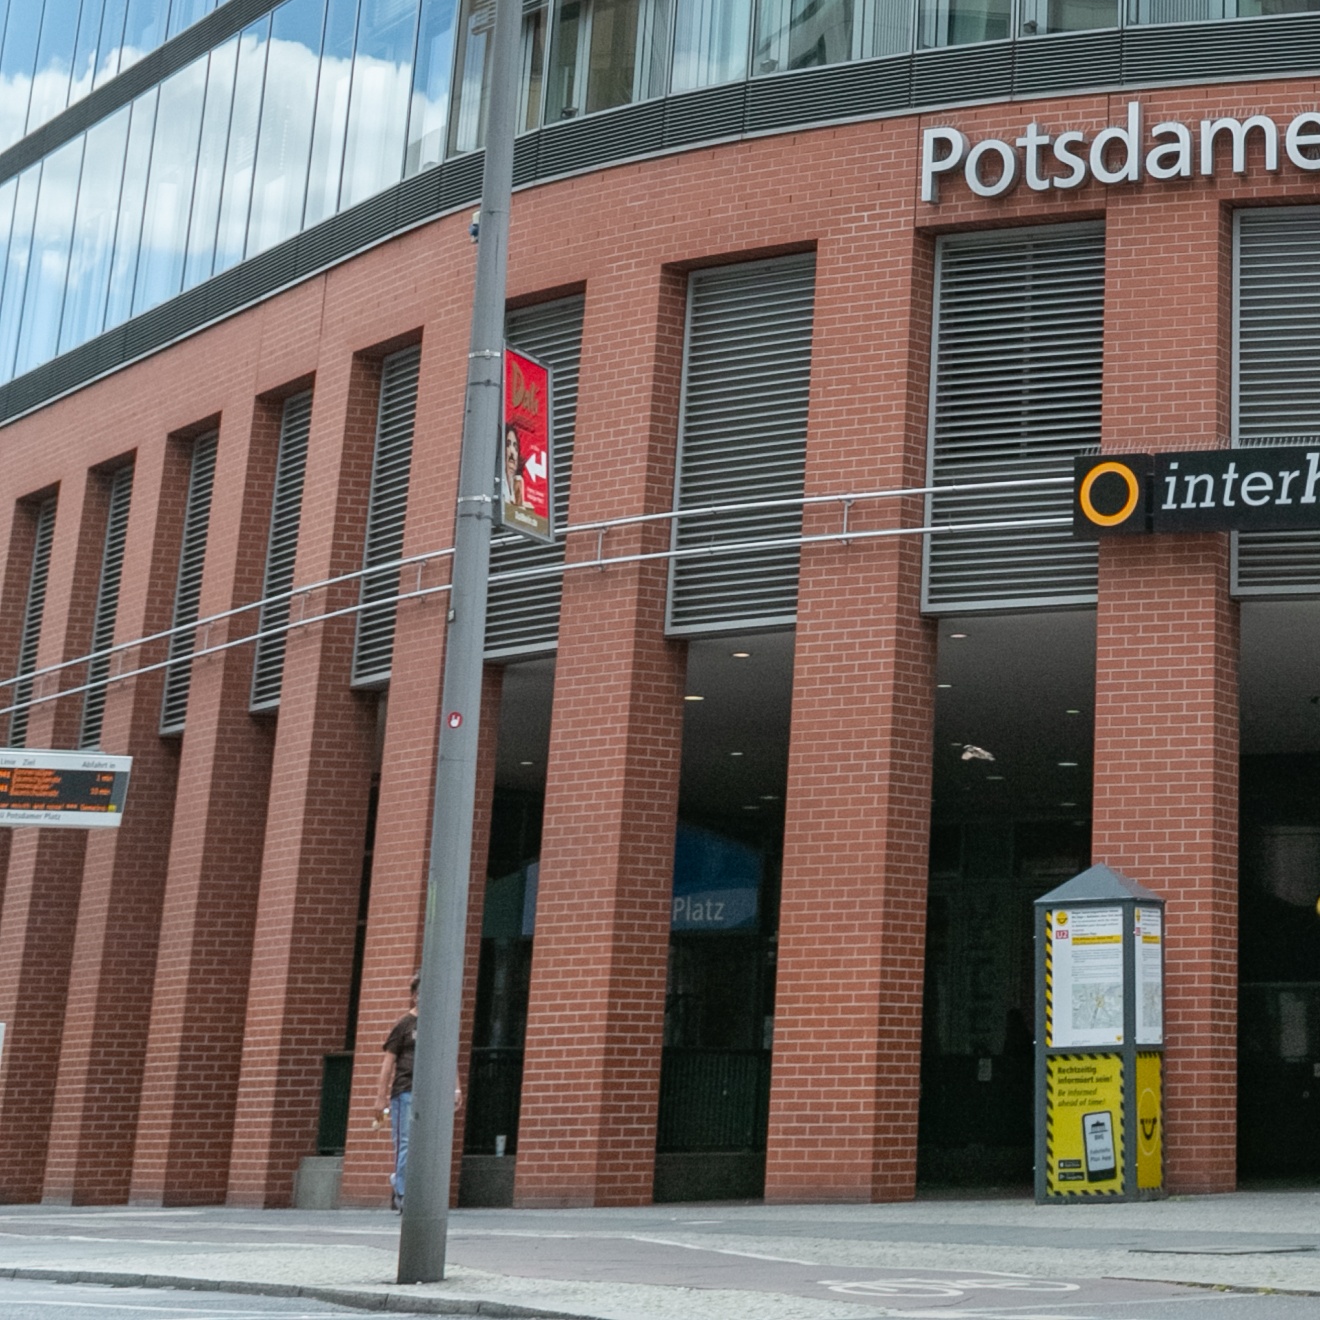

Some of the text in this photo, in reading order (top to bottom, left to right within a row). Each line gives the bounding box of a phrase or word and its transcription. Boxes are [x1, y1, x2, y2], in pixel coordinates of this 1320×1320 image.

[673, 895, 726, 922] Platz
[1057, 931, 1068, 939] U2
[1058, 1066, 1097, 1075] Rechtzeitig
[1058, 1076, 1095, 1084] informiert
[1068, 1087, 1097, 1096] informed
